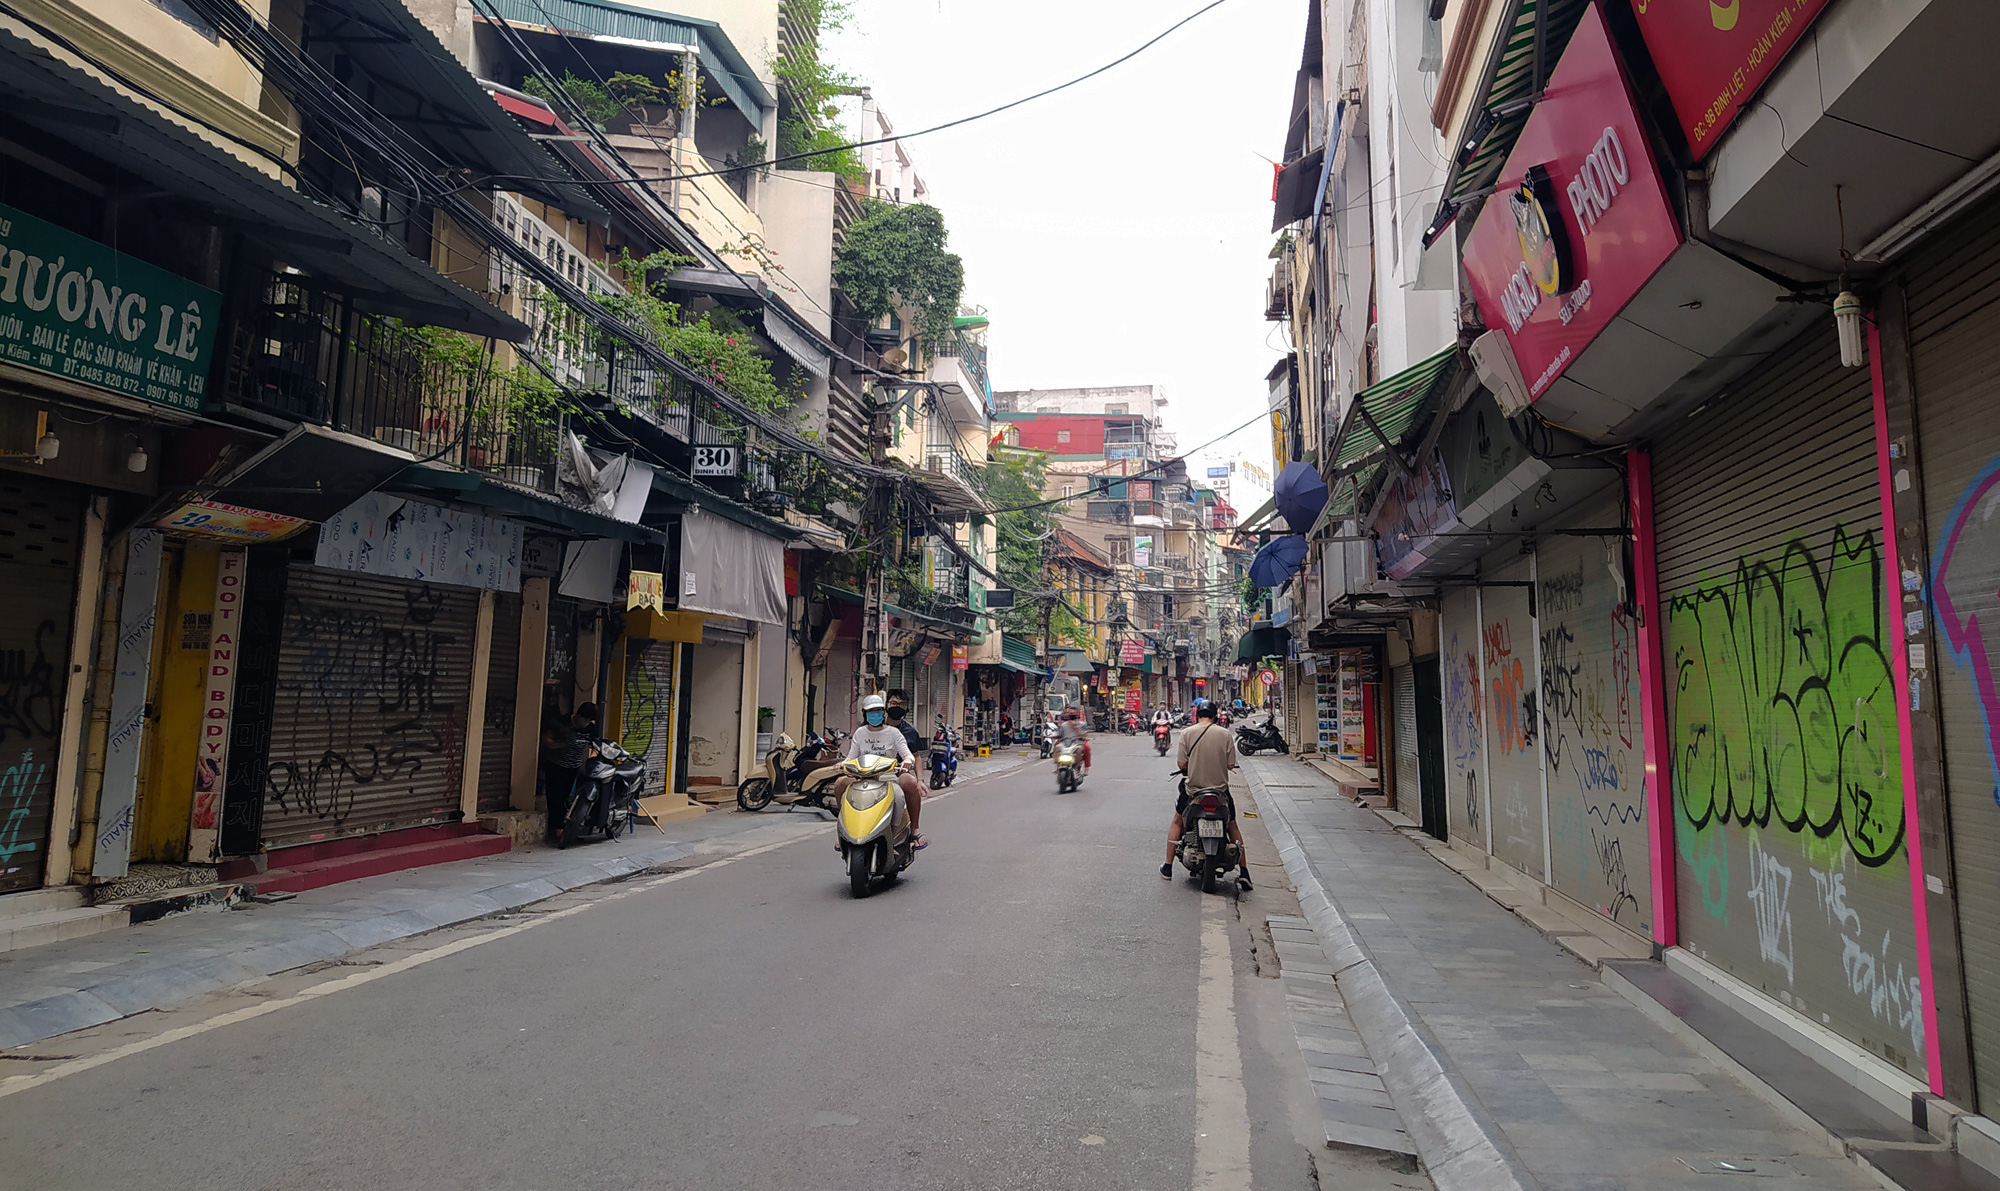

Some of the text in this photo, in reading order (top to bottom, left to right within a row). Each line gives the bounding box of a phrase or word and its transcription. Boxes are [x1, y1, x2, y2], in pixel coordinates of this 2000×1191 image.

[1704, 106, 1717, 125] 9B
[1747, 33, 1773, 71] HOÀN
[1566, 126, 1629, 237] PHOTO
[154, 299, 202, 363] LÊ
[1501, 261, 1540, 335] MAGIC
[32, 322, 56, 350] BÁN
[73, 336, 94, 361] CÁC
[158, 365, 183, 388] KHĂN
[188, 375, 206, 395] LEN
[39, 352, 54, 368] HN
[80, 365, 104, 383] 0485
[104, 372, 122, 388] 820
[122, 377, 139, 393] 872
[147, 384, 168, 401] 0907
[168, 389, 184, 405] 961
[184, 394, 200, 410] 986
[698, 448, 731, 467] 30
[172, 512, 212, 528] 32
[638, 592, 656, 606] BAG
[206, 559, 239, 754] FOOT AND BODY
